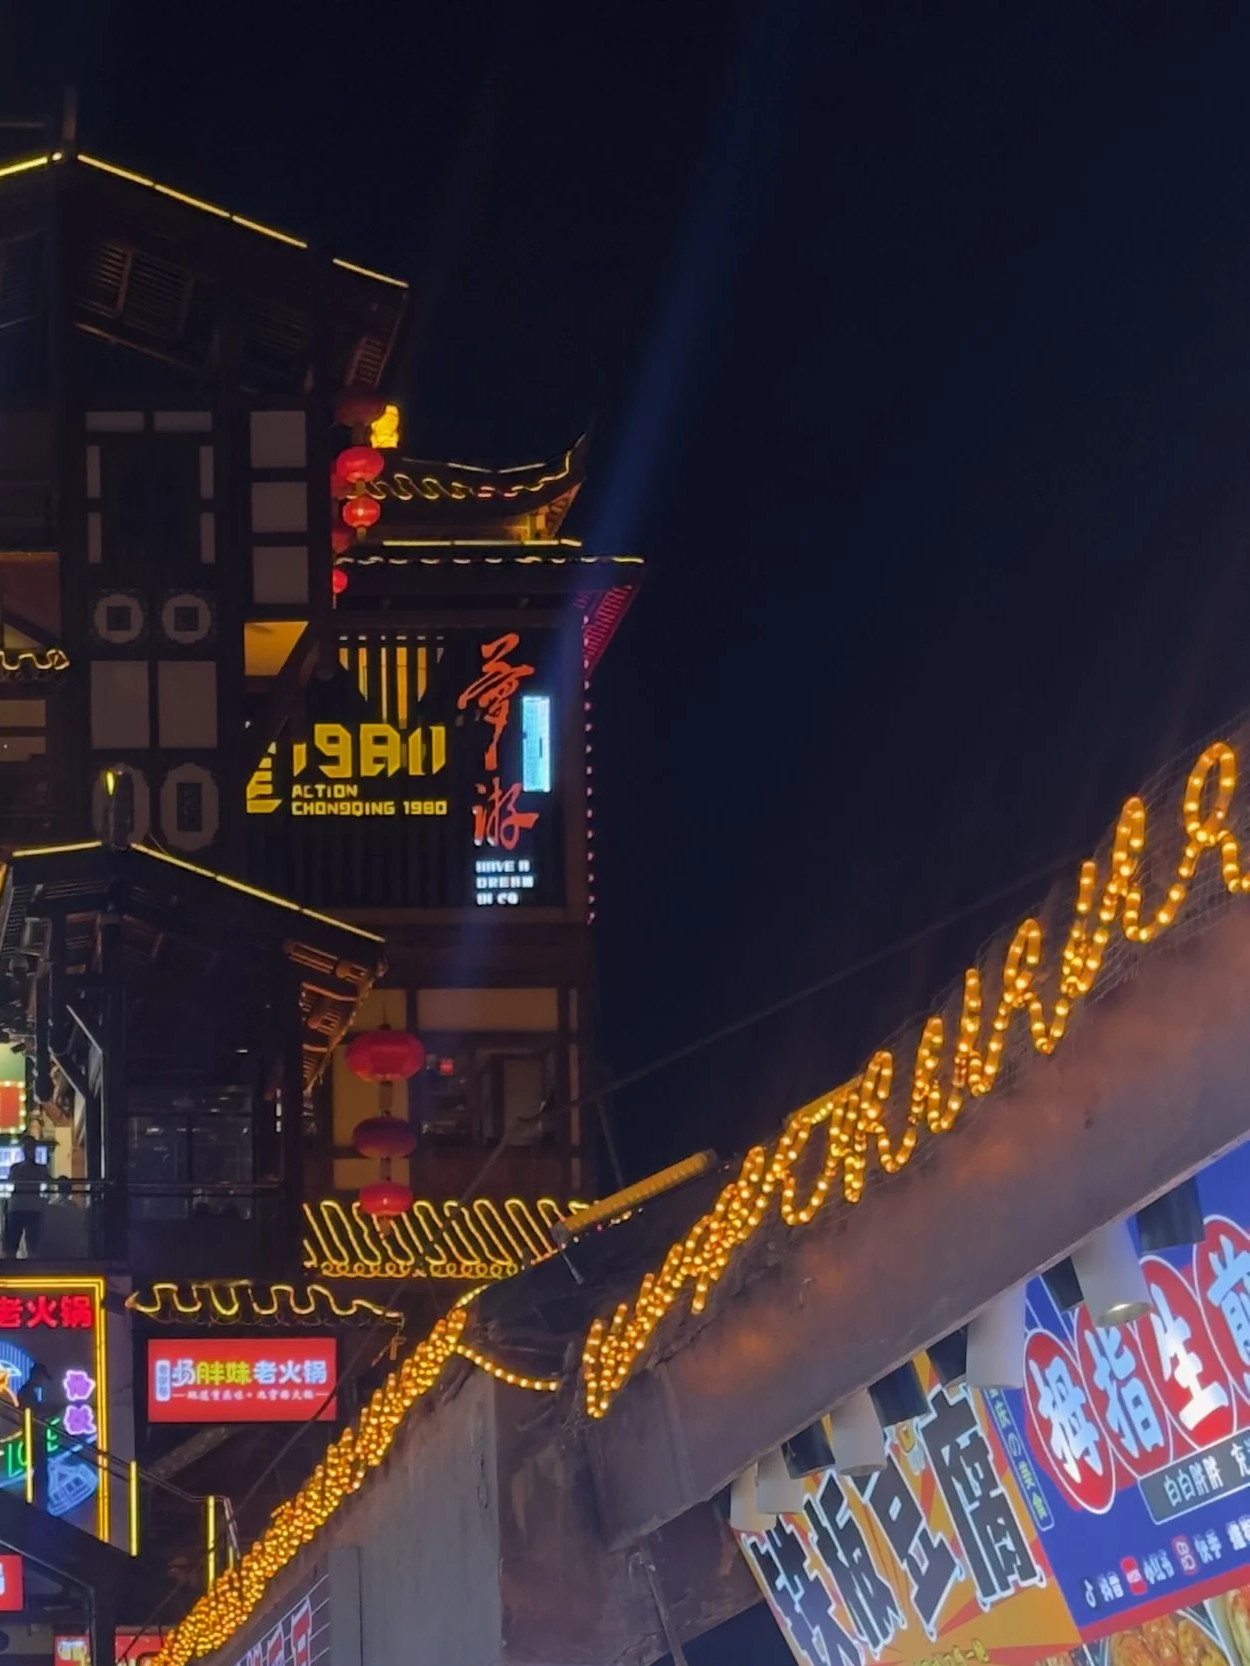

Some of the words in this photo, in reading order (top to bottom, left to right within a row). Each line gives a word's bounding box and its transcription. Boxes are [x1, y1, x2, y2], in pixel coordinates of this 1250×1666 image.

[292, 784, 358, 798] ACTION
[291, 801, 395, 816] CHONGQING
[403, 801, 448, 815] 1980
[1163, 1455, 1224, 1507] 白白胖胖
[1231, 1438, 1250, 1478] 充
